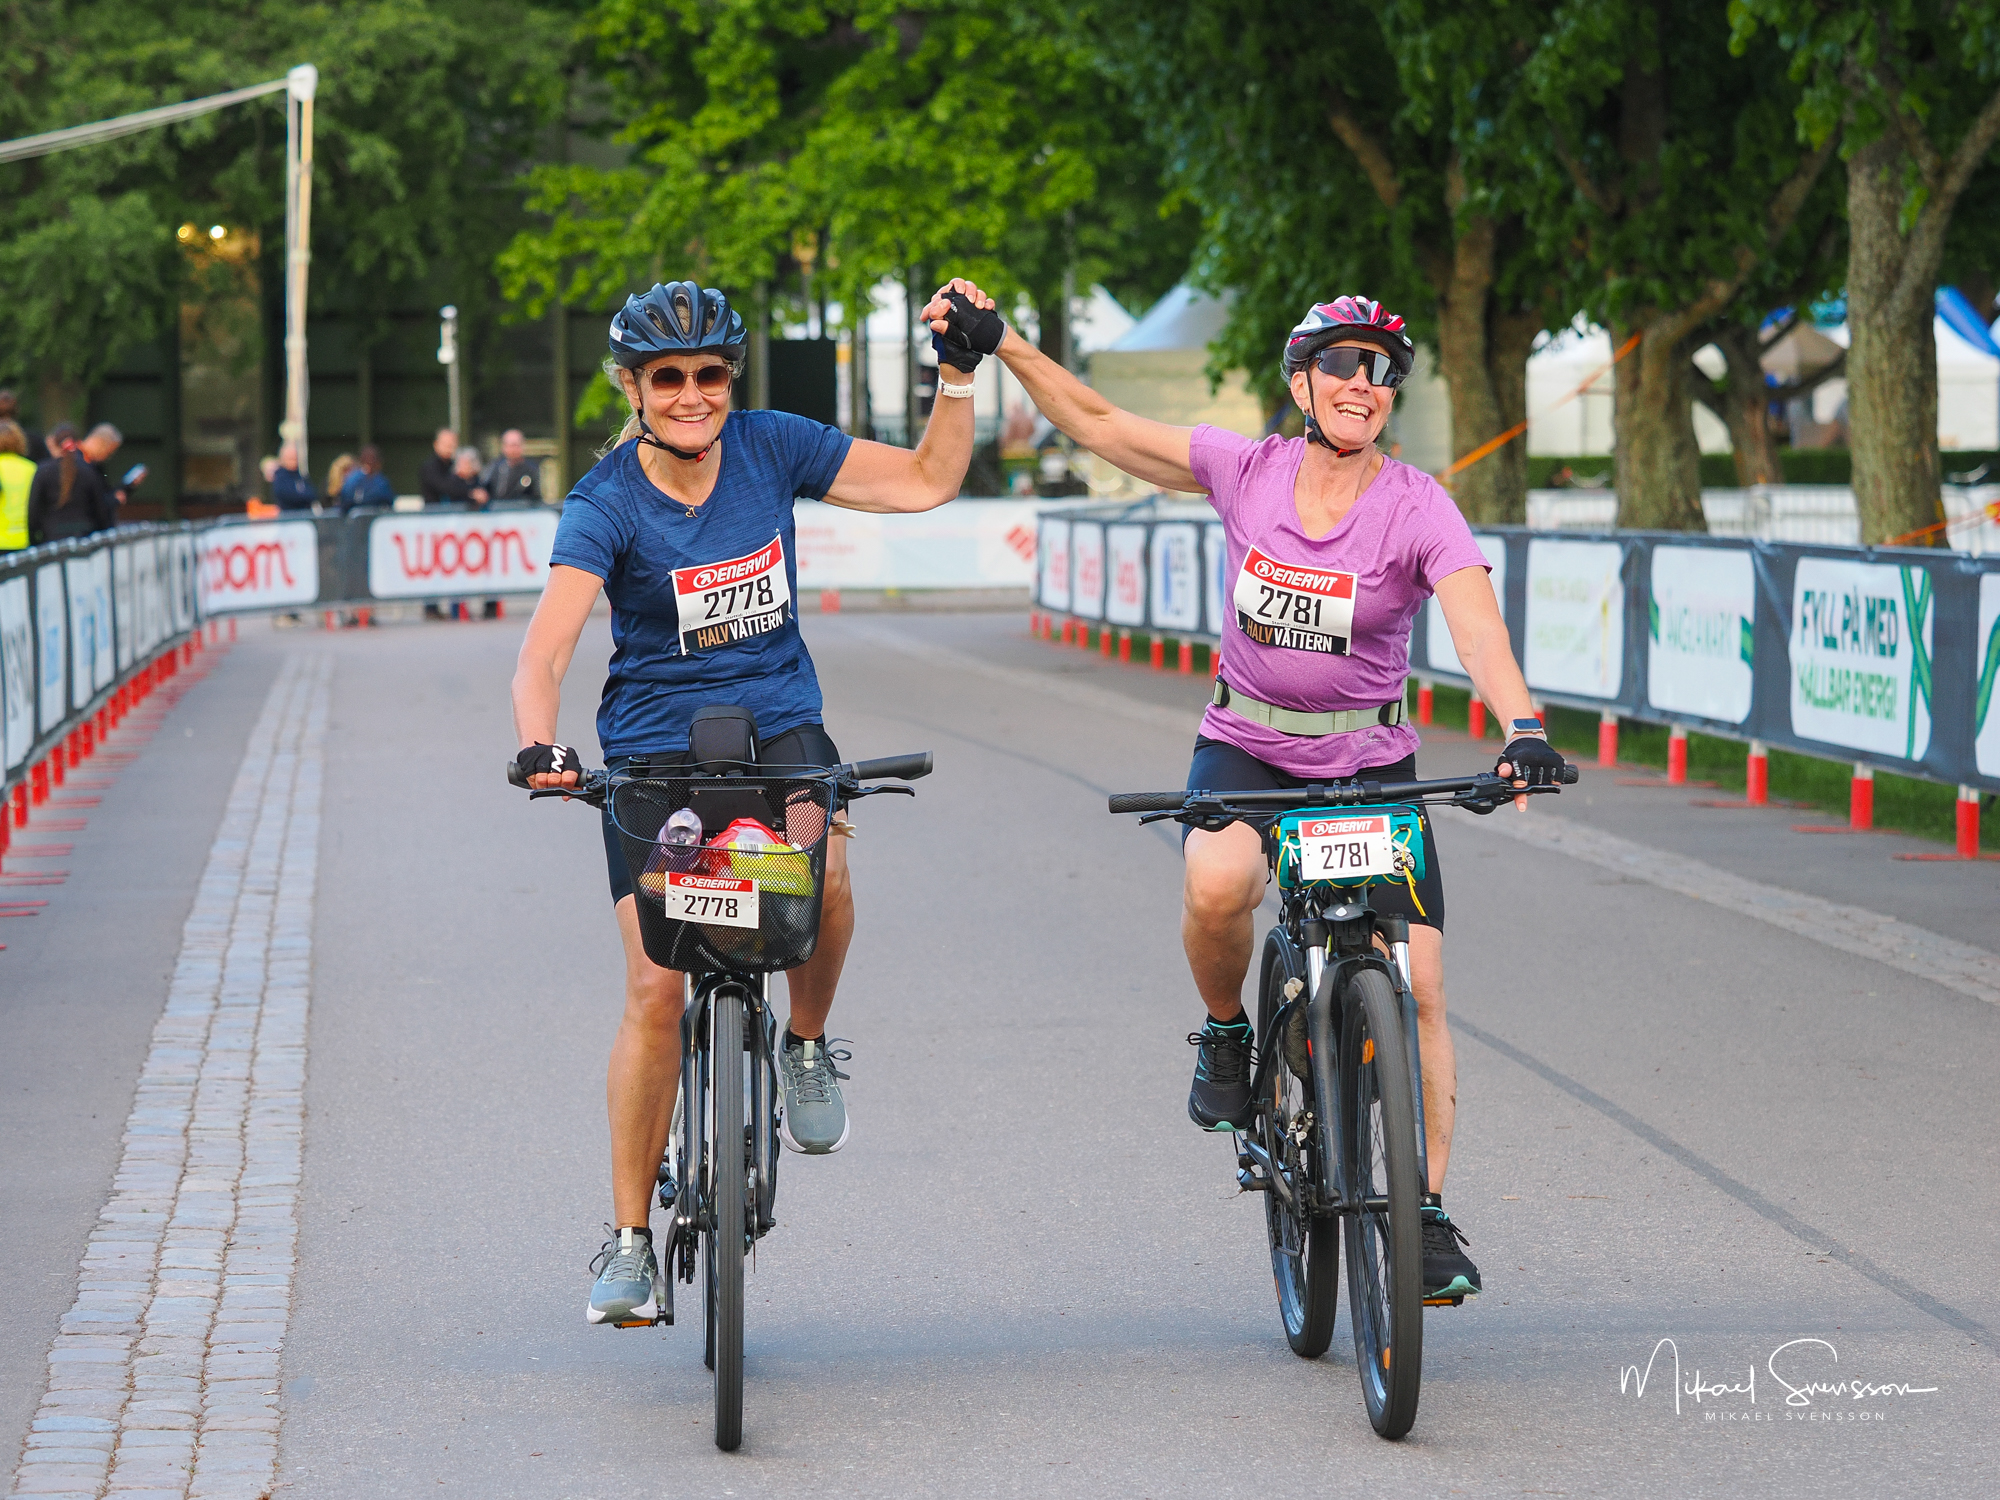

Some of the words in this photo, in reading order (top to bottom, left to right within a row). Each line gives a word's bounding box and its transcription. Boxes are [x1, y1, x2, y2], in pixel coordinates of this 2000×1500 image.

[391, 529, 536, 580] woom
[716, 549, 772, 583] ENERVIT
[1272, 567, 1338, 592] ENERVIT
[703, 574, 774, 620] 2778
[1256, 584, 1322, 627] 2781
[1801, 590, 1838, 650] FYLL
[1327, 820, 1373, 834] ENERVIT
[1321, 841, 1370, 870] 2781
[695, 878, 742, 890] ENERVIT
[684, 894, 738, 918] 2778
